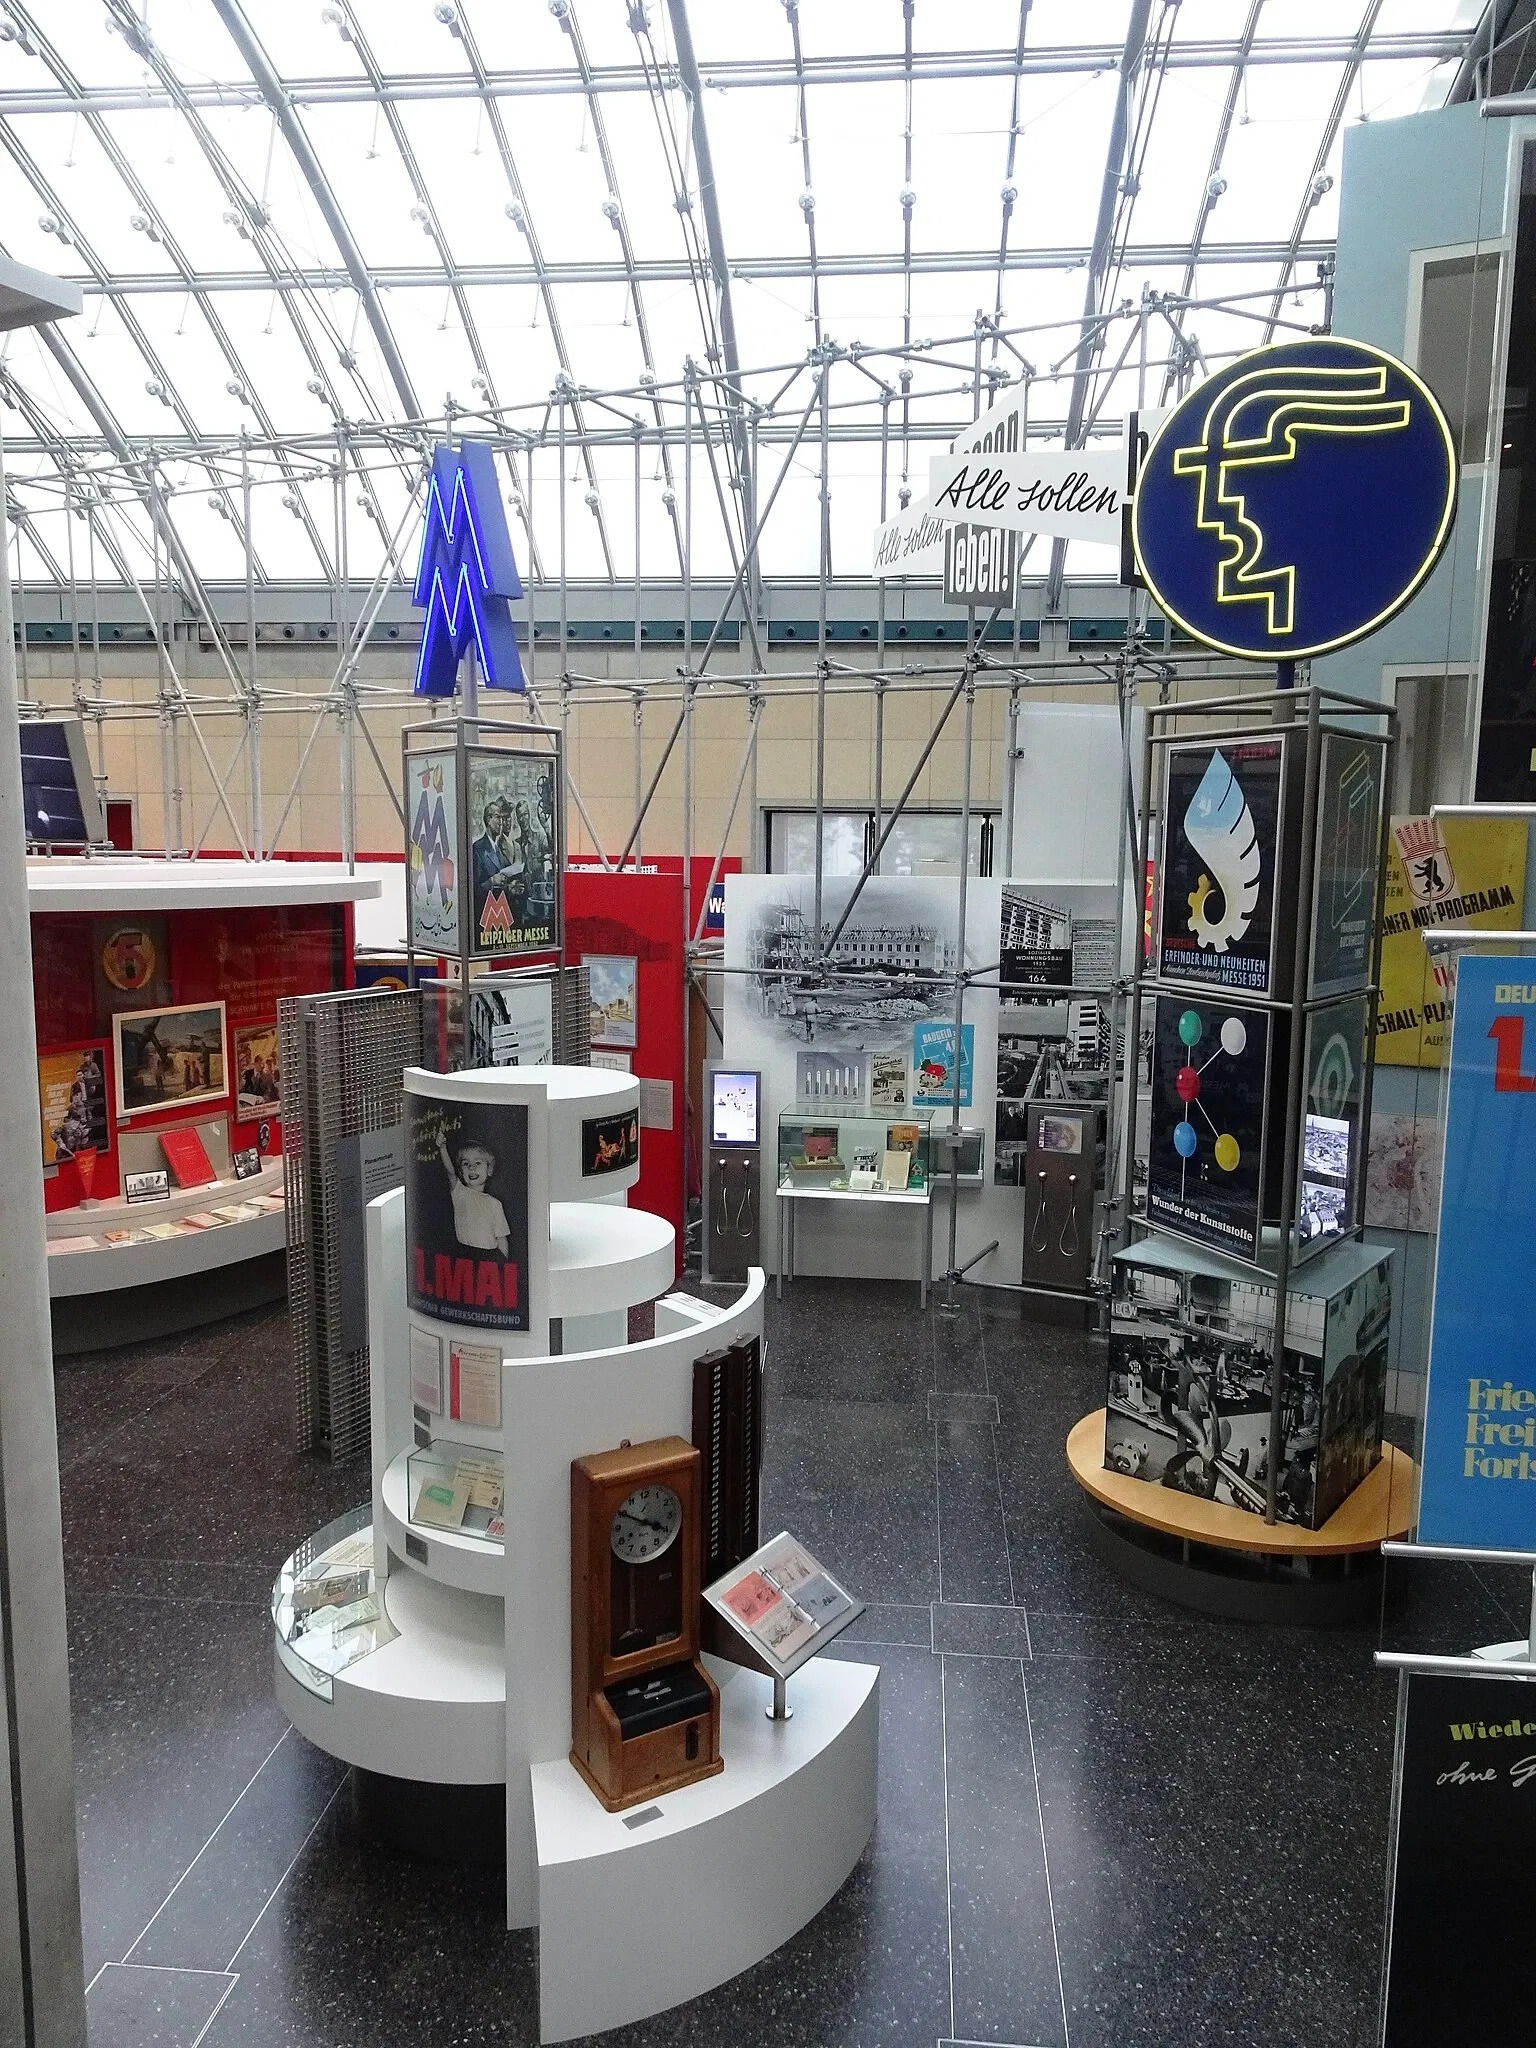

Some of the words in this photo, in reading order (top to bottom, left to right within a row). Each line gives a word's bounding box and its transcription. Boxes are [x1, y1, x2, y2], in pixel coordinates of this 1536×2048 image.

[935, 465, 1010, 510] Alle
[1017, 472, 1119, 514] sollen
[874, 526, 902, 569] Alle
[903, 512, 944, 557] sollen
[949, 523, 1010, 594] leben!
[1410, 884, 1515, 930] NOT-PROGRAMM
[523, 926, 550, 942] MESSE
[1220, 955, 1266, 973] NEUHEITEN
[1028, 974, 1047, 983] 164
[1222, 969, 1247, 985] MESSE
[1247, 973, 1266, 988] 1951
[1495, 984, 1536, 1004] DEU
[922, 1028, 952, 1044] BAUGELD
[1152, 1195, 1183, 1215] Wunder
[1184, 1208, 1199, 1221] der
[1200, 1213, 1253, 1242] Kunststoffe
[440, 1305, 521, 1325] GEWERKSCHAFTSBUND
[1468, 1379, 1535, 1412] Frie
[1466, 1413, 1535, 1446] Frei
[1448, 1719, 1536, 1741] Wiede
[1436, 1761, 1498, 1786] ohne
